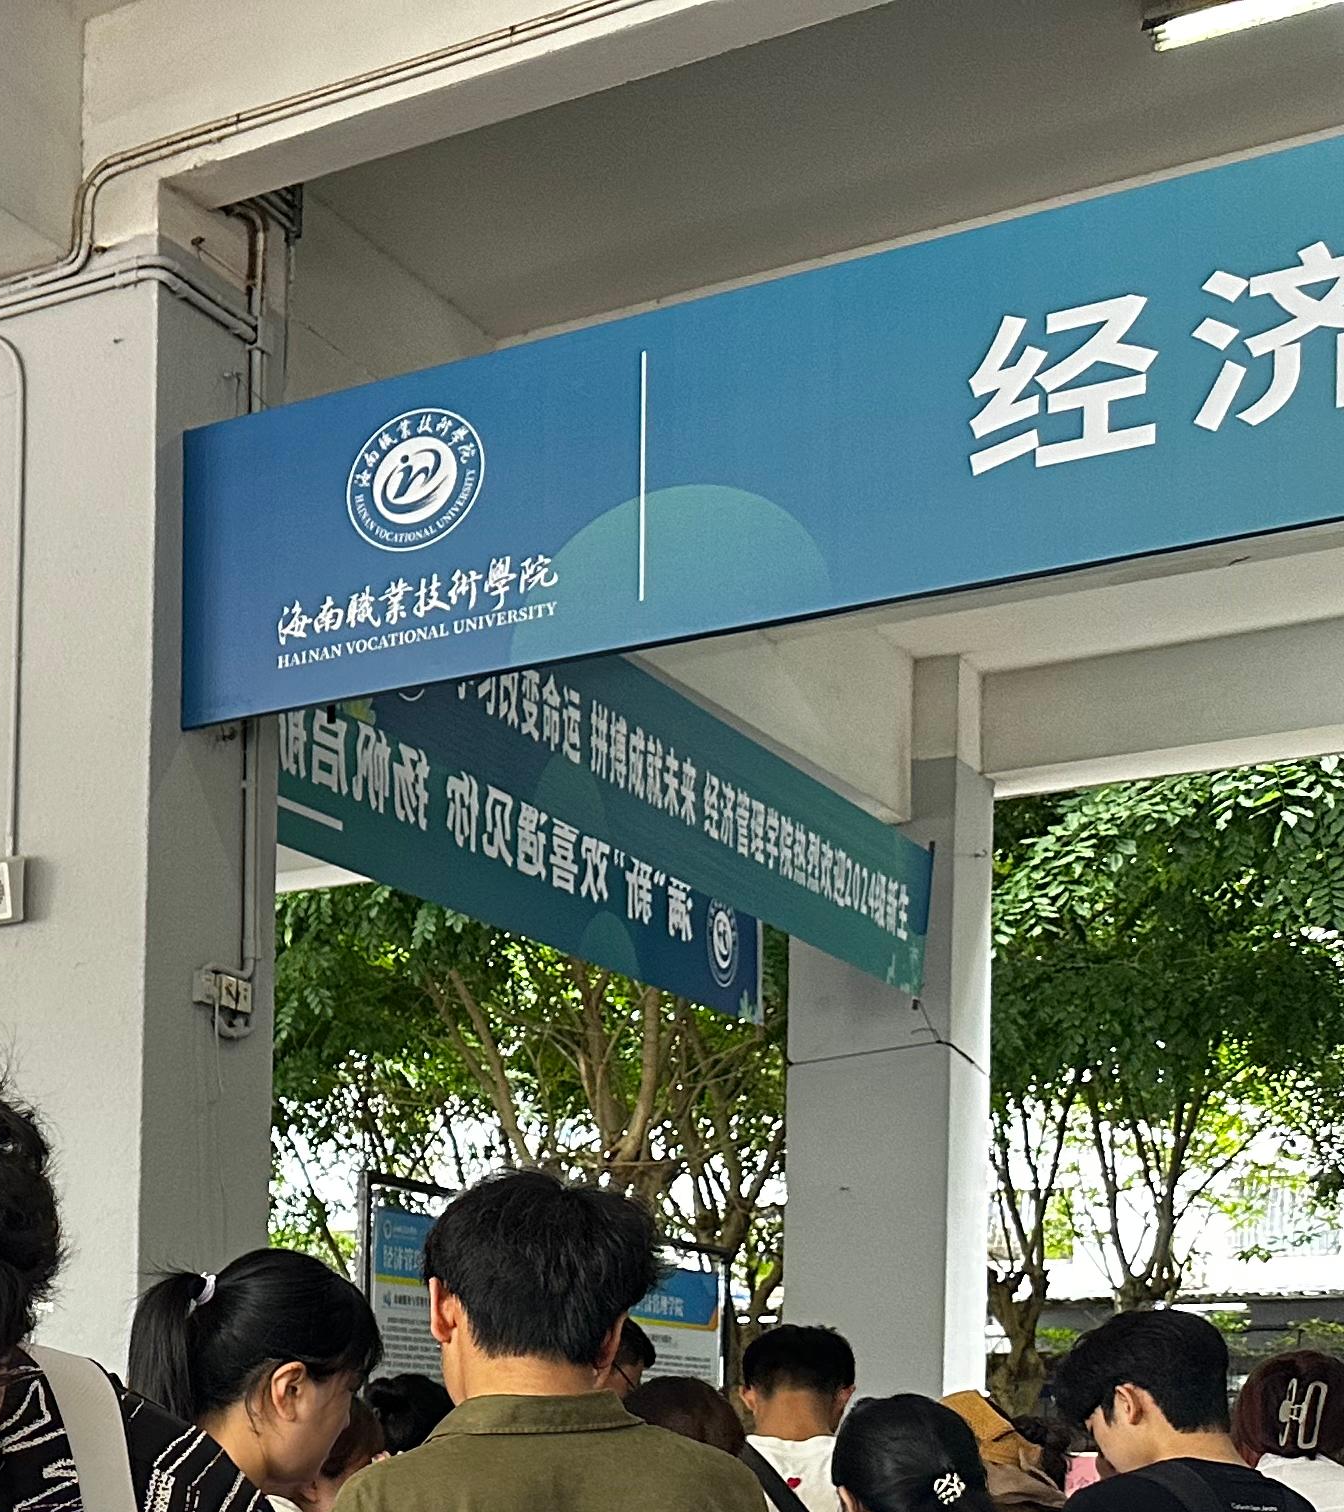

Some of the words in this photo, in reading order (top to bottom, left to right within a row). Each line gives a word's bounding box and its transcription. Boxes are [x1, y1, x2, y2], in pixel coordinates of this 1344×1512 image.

[277, 640, 342, 669] HAINAN
[346, 624, 449, 655] VOCATIONAL
[453, 601, 558, 636] UNIVERSITY
[590, 698, 697, 826] 拼搏成就未来
